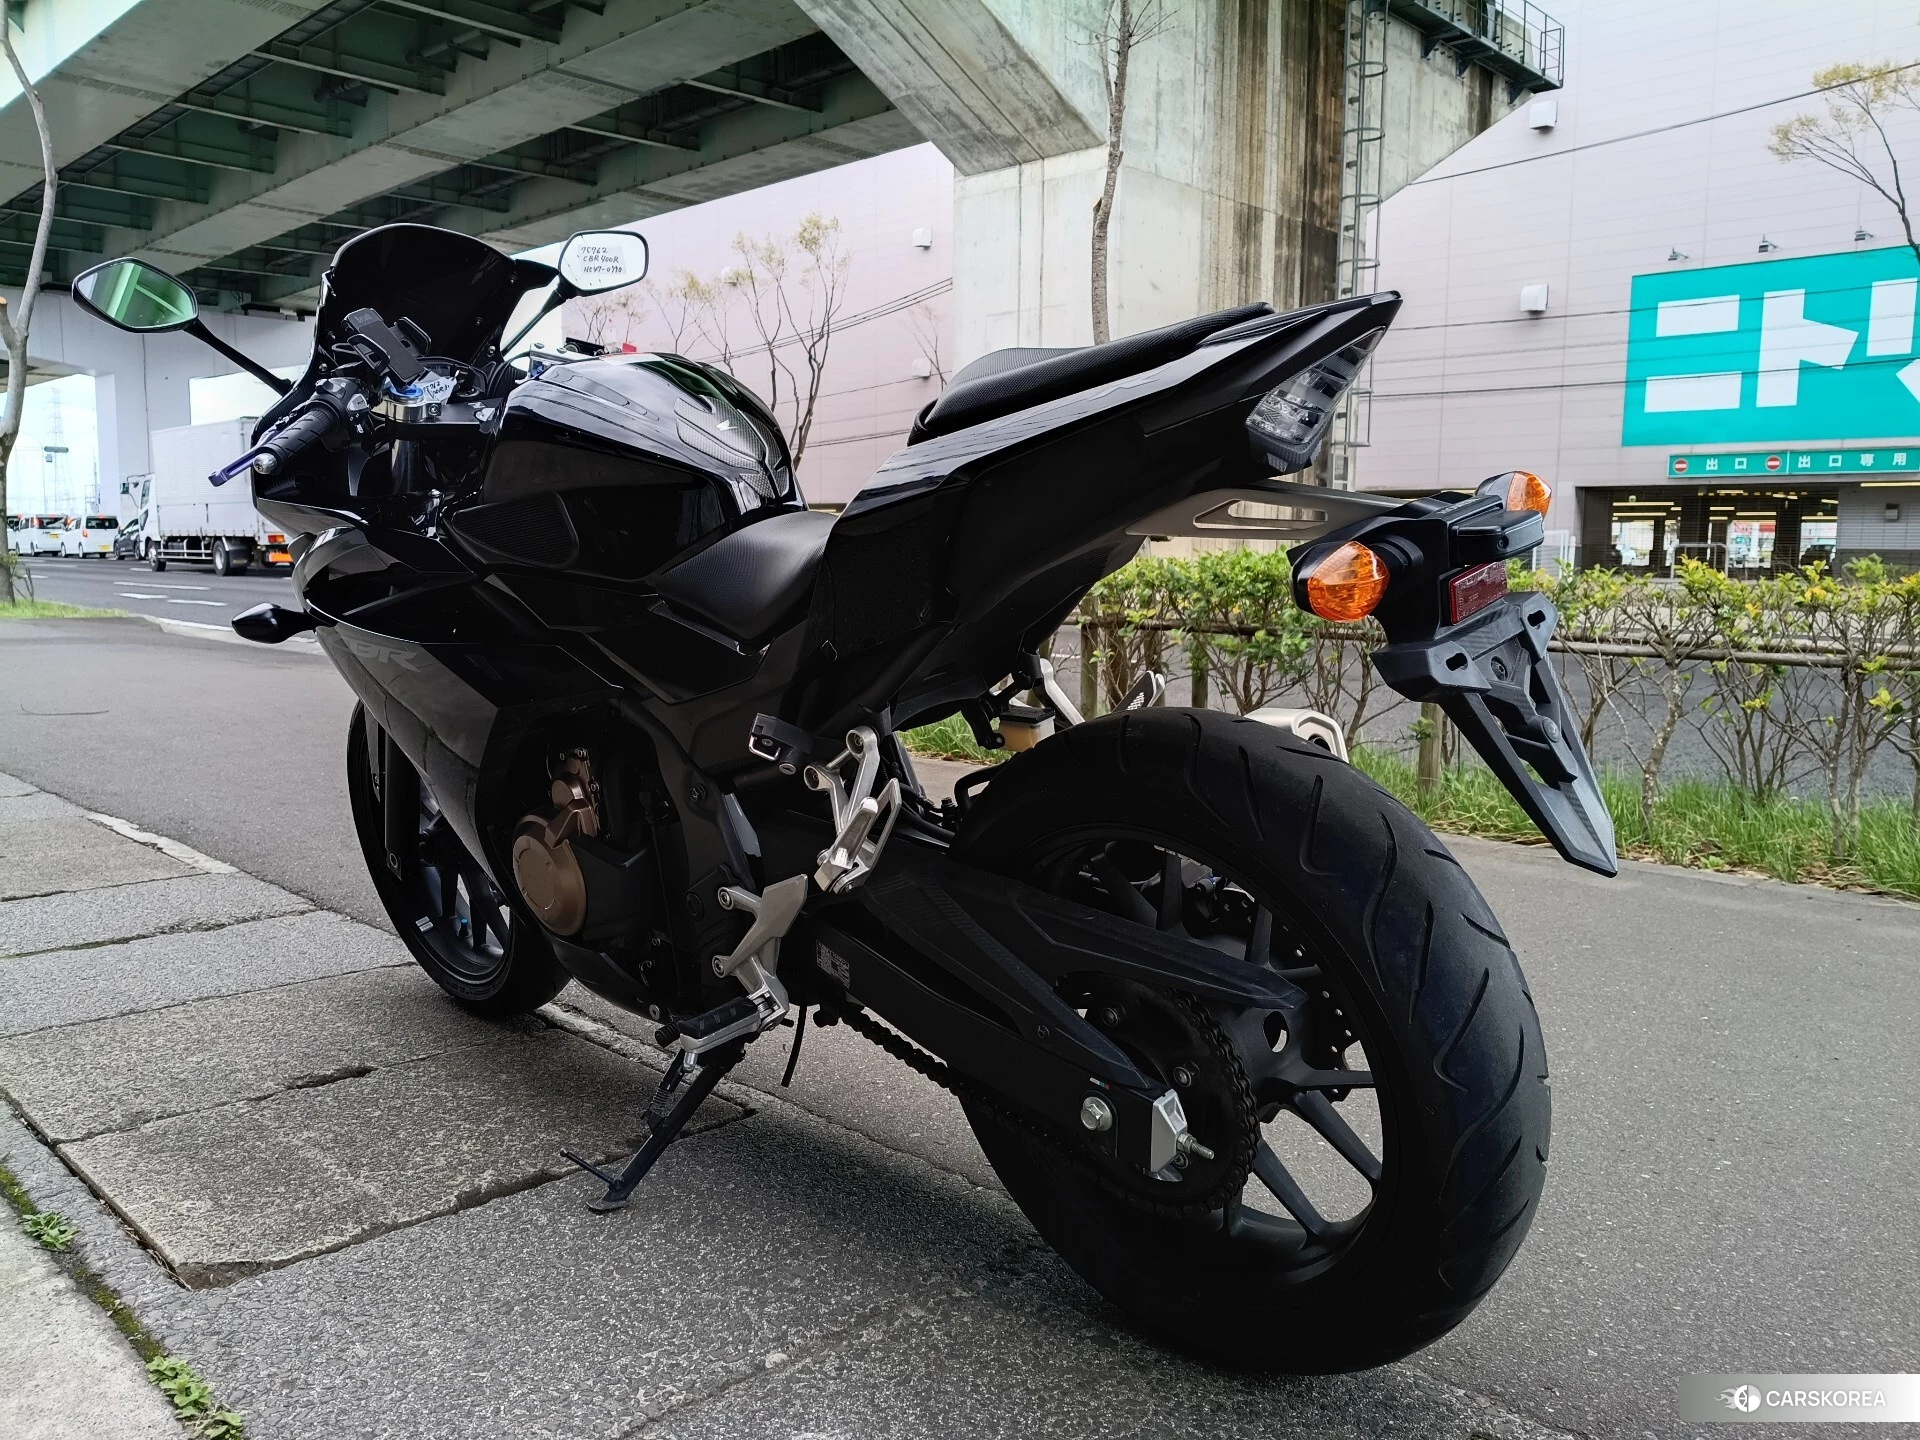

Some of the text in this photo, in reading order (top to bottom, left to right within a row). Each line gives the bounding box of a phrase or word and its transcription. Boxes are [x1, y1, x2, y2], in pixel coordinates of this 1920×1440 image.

[1706, 457, 1747, 471] 出口
[1798, 452, 1907, 468] 出口専用
